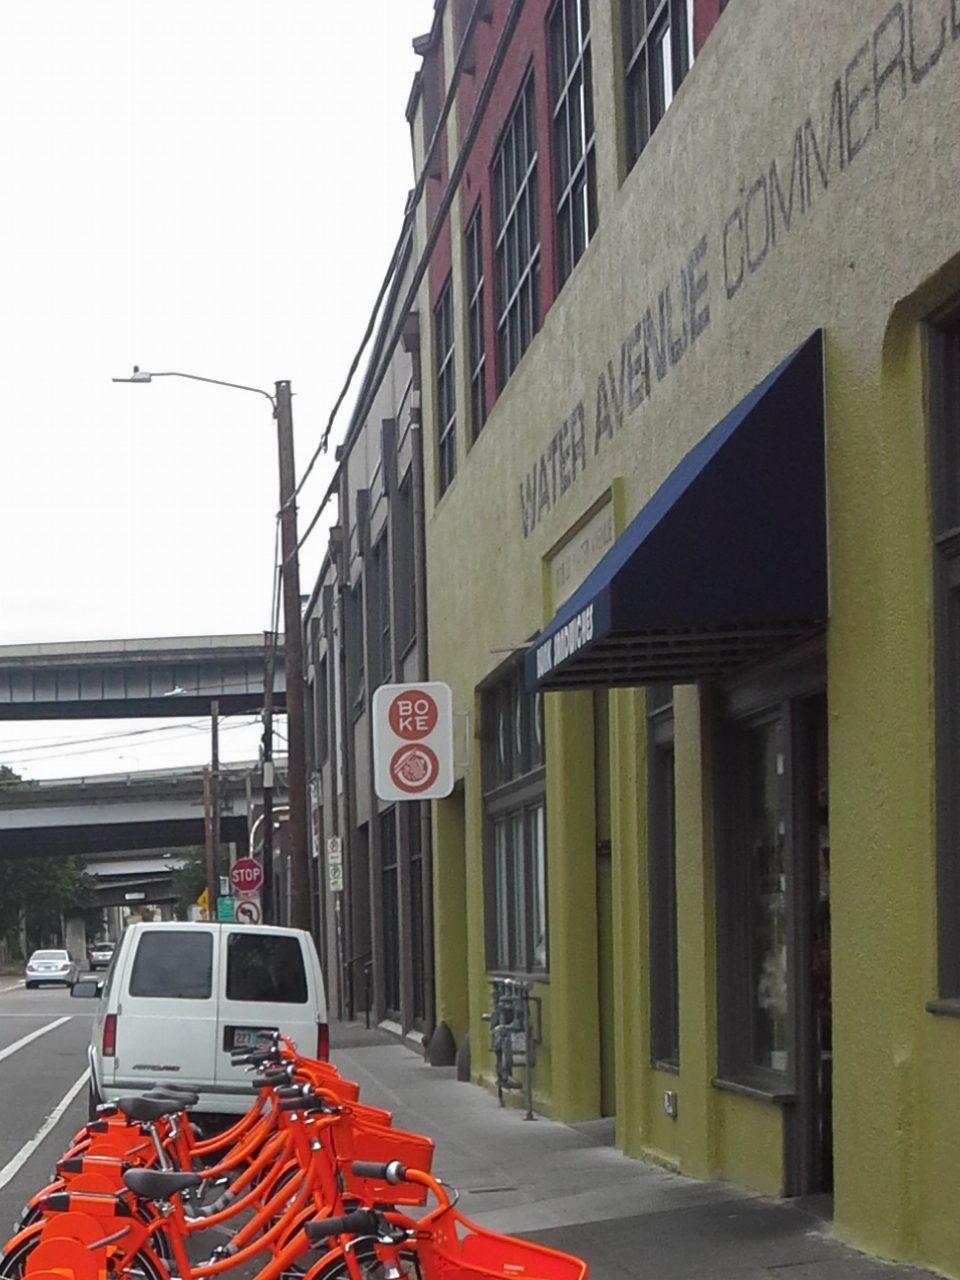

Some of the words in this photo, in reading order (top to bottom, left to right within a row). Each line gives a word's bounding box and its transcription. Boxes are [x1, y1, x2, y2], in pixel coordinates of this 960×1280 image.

[519, 400, 585, 539] WATER
[594, 234, 711, 456] AVENUE
[232, 868, 261, 882] STOP
